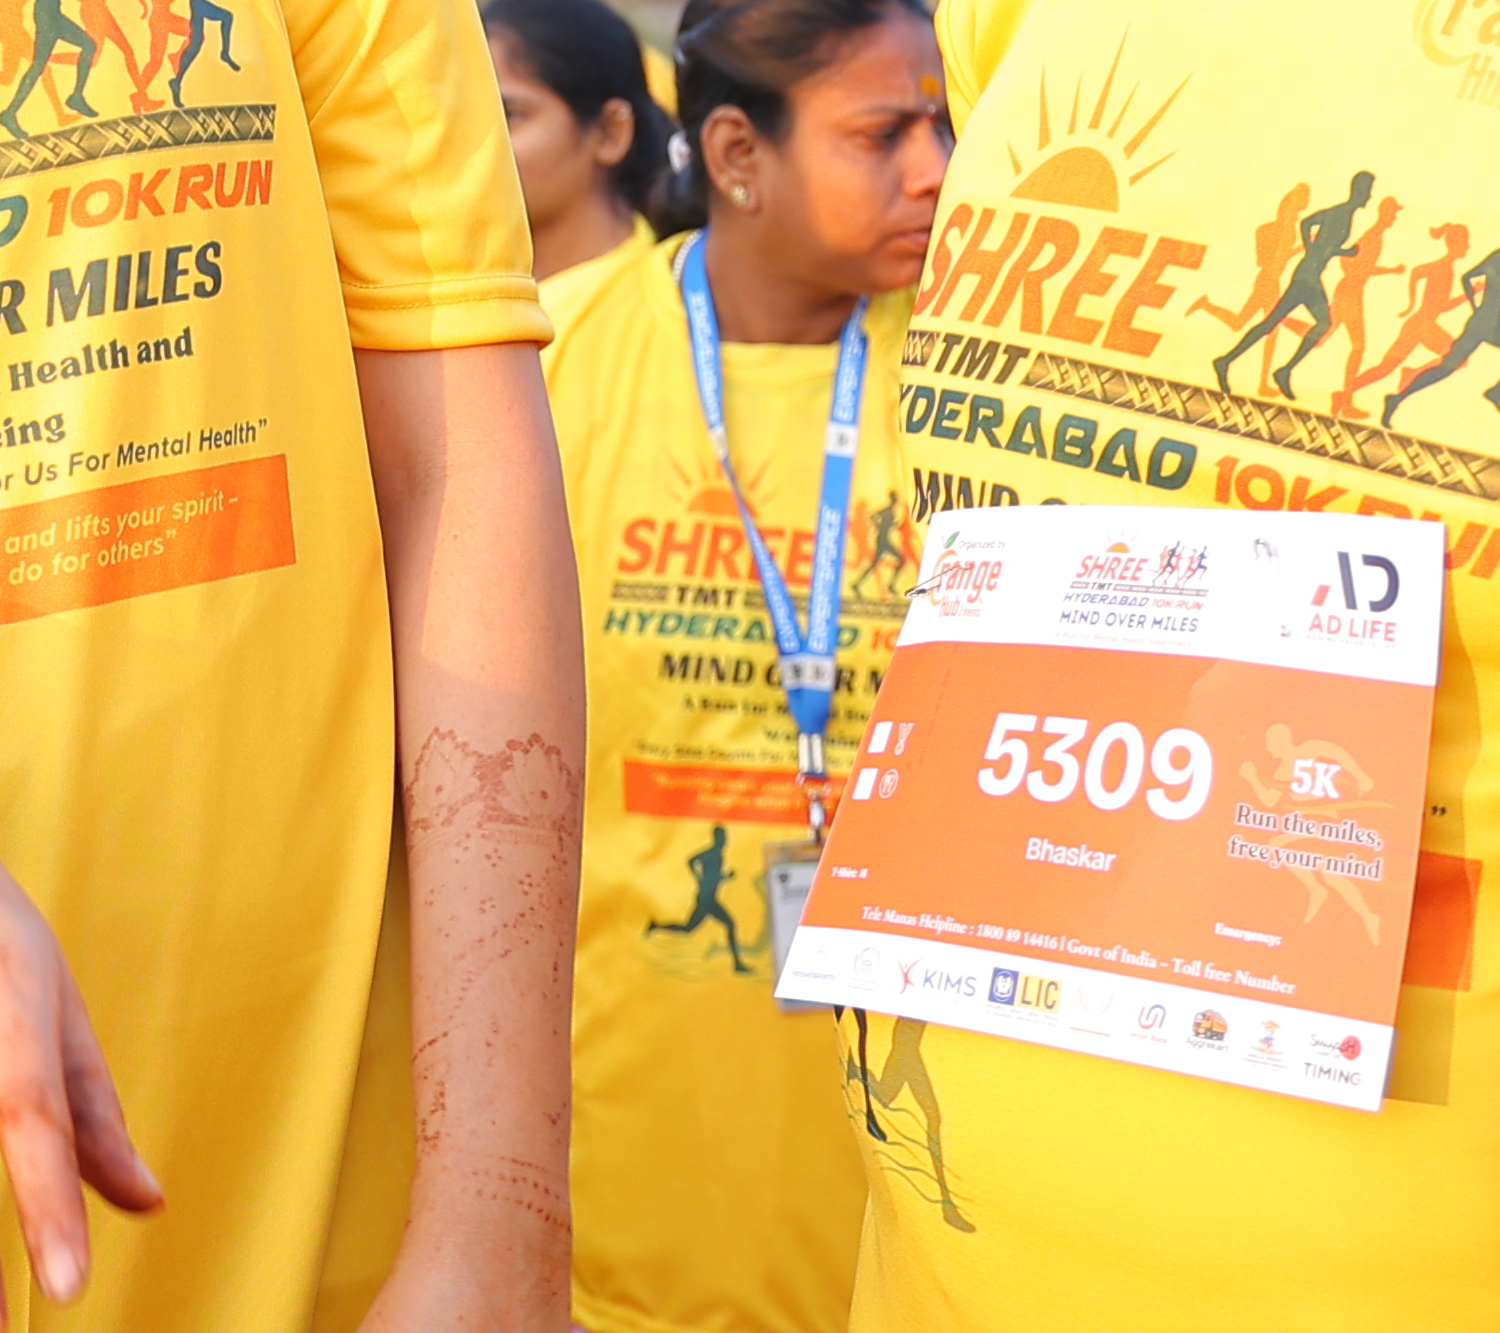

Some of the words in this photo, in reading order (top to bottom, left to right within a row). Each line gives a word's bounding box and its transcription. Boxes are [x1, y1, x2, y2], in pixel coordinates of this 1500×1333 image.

[45, 239, 224, 329] MILES
[912, 203, 1208, 358] SHREE
[8, 337, 131, 392] Health
[135, 325, 194, 363] and
[934, 331, 1030, 386] TMT
[23, 461, 58, 486] Us
[67, 450, 110, 477] For
[115, 430, 192, 469] Mental
[4, 521, 58, 557] and
[64, 514, 111, 544] lifts
[114, 503, 166, 541] your
[171, 488, 226, 525] spirit
[958, 538, 996, 550] Organized
[997, 539, 1006, 551] by
[7, 561, 43, 586] do
[51, 549, 91, 576] for
[1075, 554, 1149, 582] SHREE
[675, 583, 737, 608] TMT
[1063, 591, 1150, 608] HYDERABAD
[1151, 597, 1174, 610] 10K
[1174, 598, 1204, 611] RUN
[1090, 582, 1113, 592] TMT
[938, 595, 960, 618] Hub
[1059, 609, 1102, 626] MIND
[1105, 610, 1148, 630] OVER
[1151, 615, 1200, 634] MILES
[1308, 612, 1343, 636] AD
[1348, 617, 1398, 643] LIFE
[660, 653, 754, 684] MIND
[977, 711, 1214, 822] 5309
[1290, 758, 1342, 799] 5K
[1236, 804, 1279, 830] Run
[1284, 812, 1316, 836] the
[1320, 820, 1383, 850] miles,
[1024, 836, 1117, 873] Bhaskar
[1228, 836, 1270, 861] free
[1269, 847, 1322, 869] your
[1325, 855, 1383, 881] mind
[861, 906, 883, 922] Tele
[883, 908, 918, 928] Manas
[918, 913, 967, 936] Helpline
[977, 923, 1005, 941] 1800
[1005, 928, 1020, 943] 89
[1023, 931, 1059, 952] 14416
[1066, 938, 1101, 959] Govt
[1102, 944, 1123, 963] of
[1120, 948, 1158, 970] India
[1171, 957, 1202, 979] Toll
[1203, 961, 1233, 984] free
[1234, 970, 1297, 996] Number
[1214, 921, 1283, 947] Emergency:
[922, 968, 978, 997] KIMS
[1021, 975, 1059, 1011] LIC
[1303, 1061, 1363, 1087] TIMING
